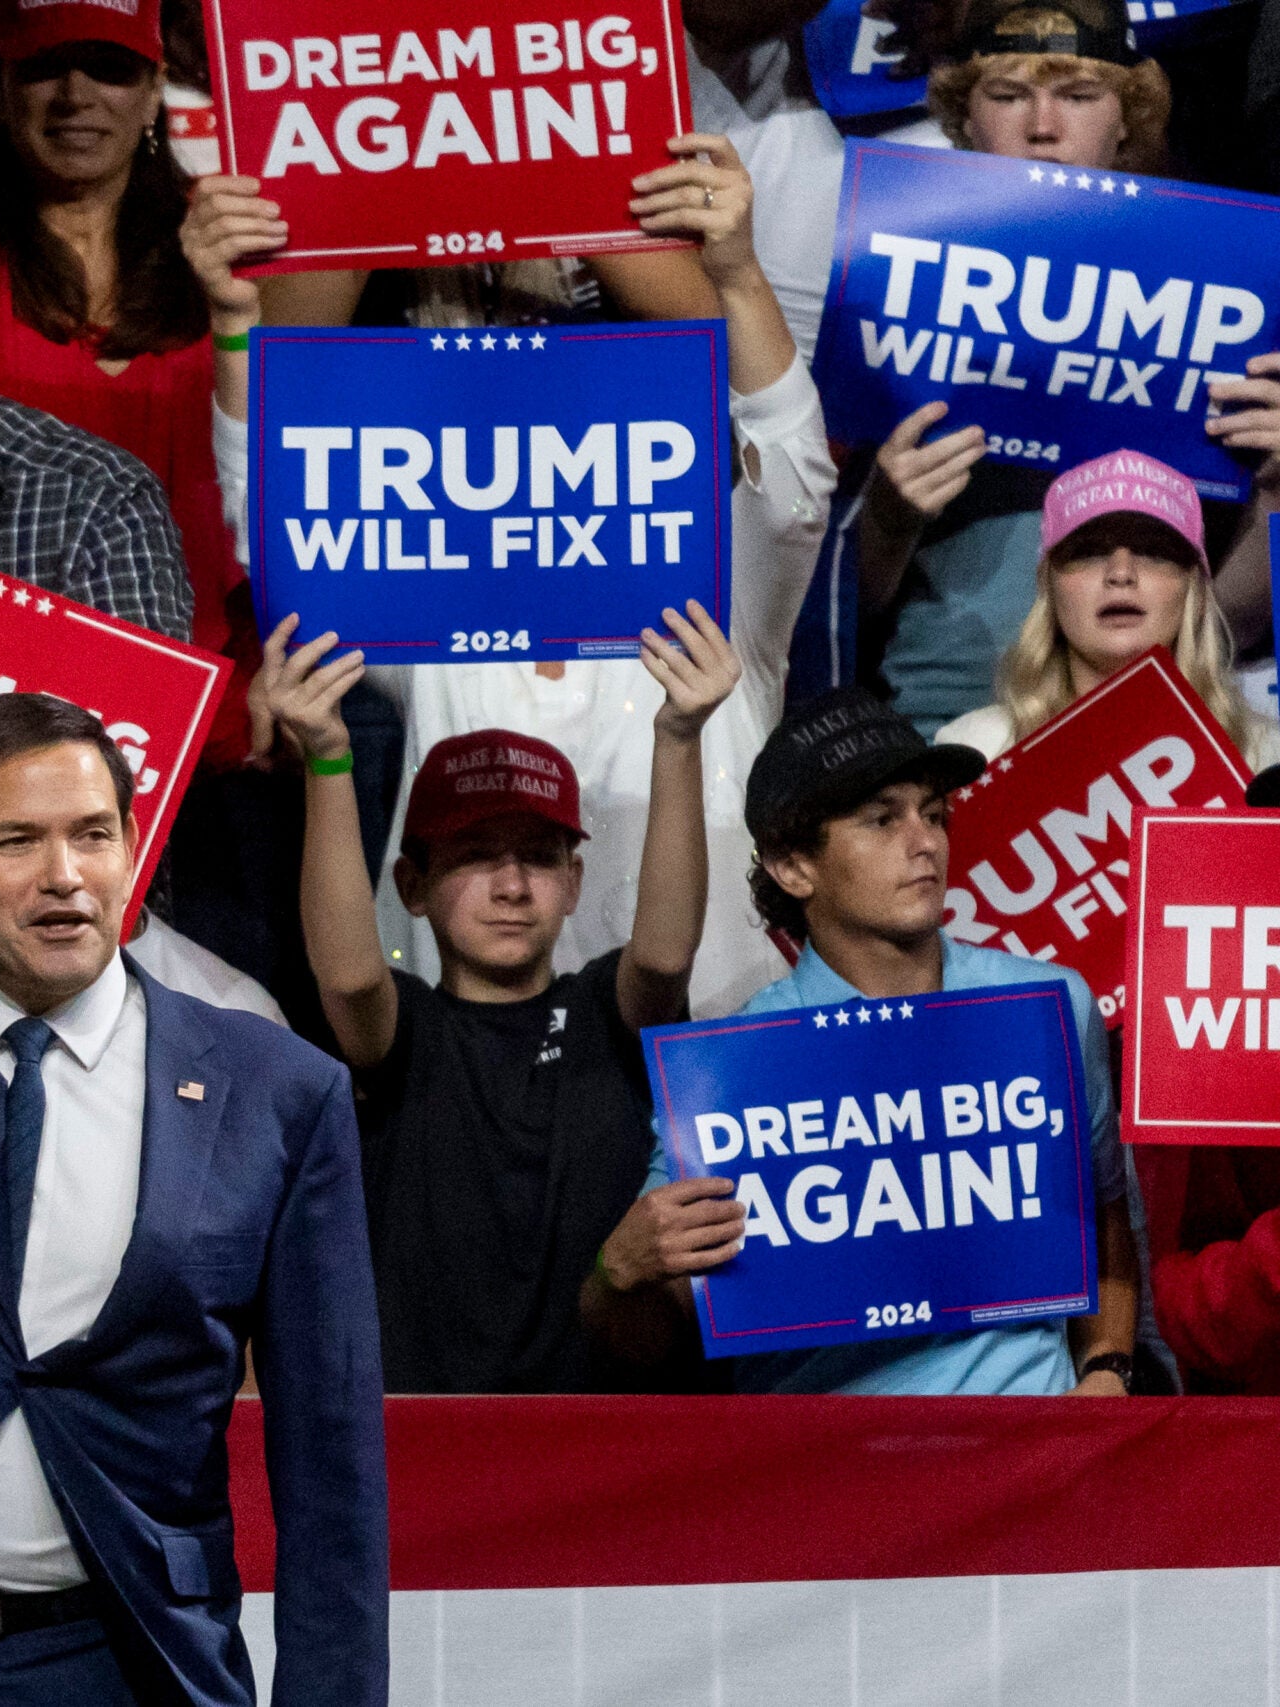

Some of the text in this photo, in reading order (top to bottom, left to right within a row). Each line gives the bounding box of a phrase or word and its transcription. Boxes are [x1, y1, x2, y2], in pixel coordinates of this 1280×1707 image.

[242, 15, 658, 91] DREAM BIG,
[262, 80, 632, 179] AGAIN!
[426, 230, 505, 257] 2024
[870, 232, 1266, 364] TRUMP
[859, 318, 1028, 391] WILL
[1046, 350, 1165, 408] FIX
[281, 420, 697, 511] TRUMP
[986, 434, 1061, 462] 2024
[284, 511, 694, 571] WILL FIX IT
[450, 630, 531, 653] 2024
[444, 747, 563, 780] MAKE AMERICA
[456, 772, 559, 801] GREAT AGAIN
[942, 735, 1196, 945] RUMP
[695, 1076, 1064, 1165] DREAM BIG,
[735, 1142, 1042, 1250] AGAIN!
[865, 1300, 933, 1329] 2024
